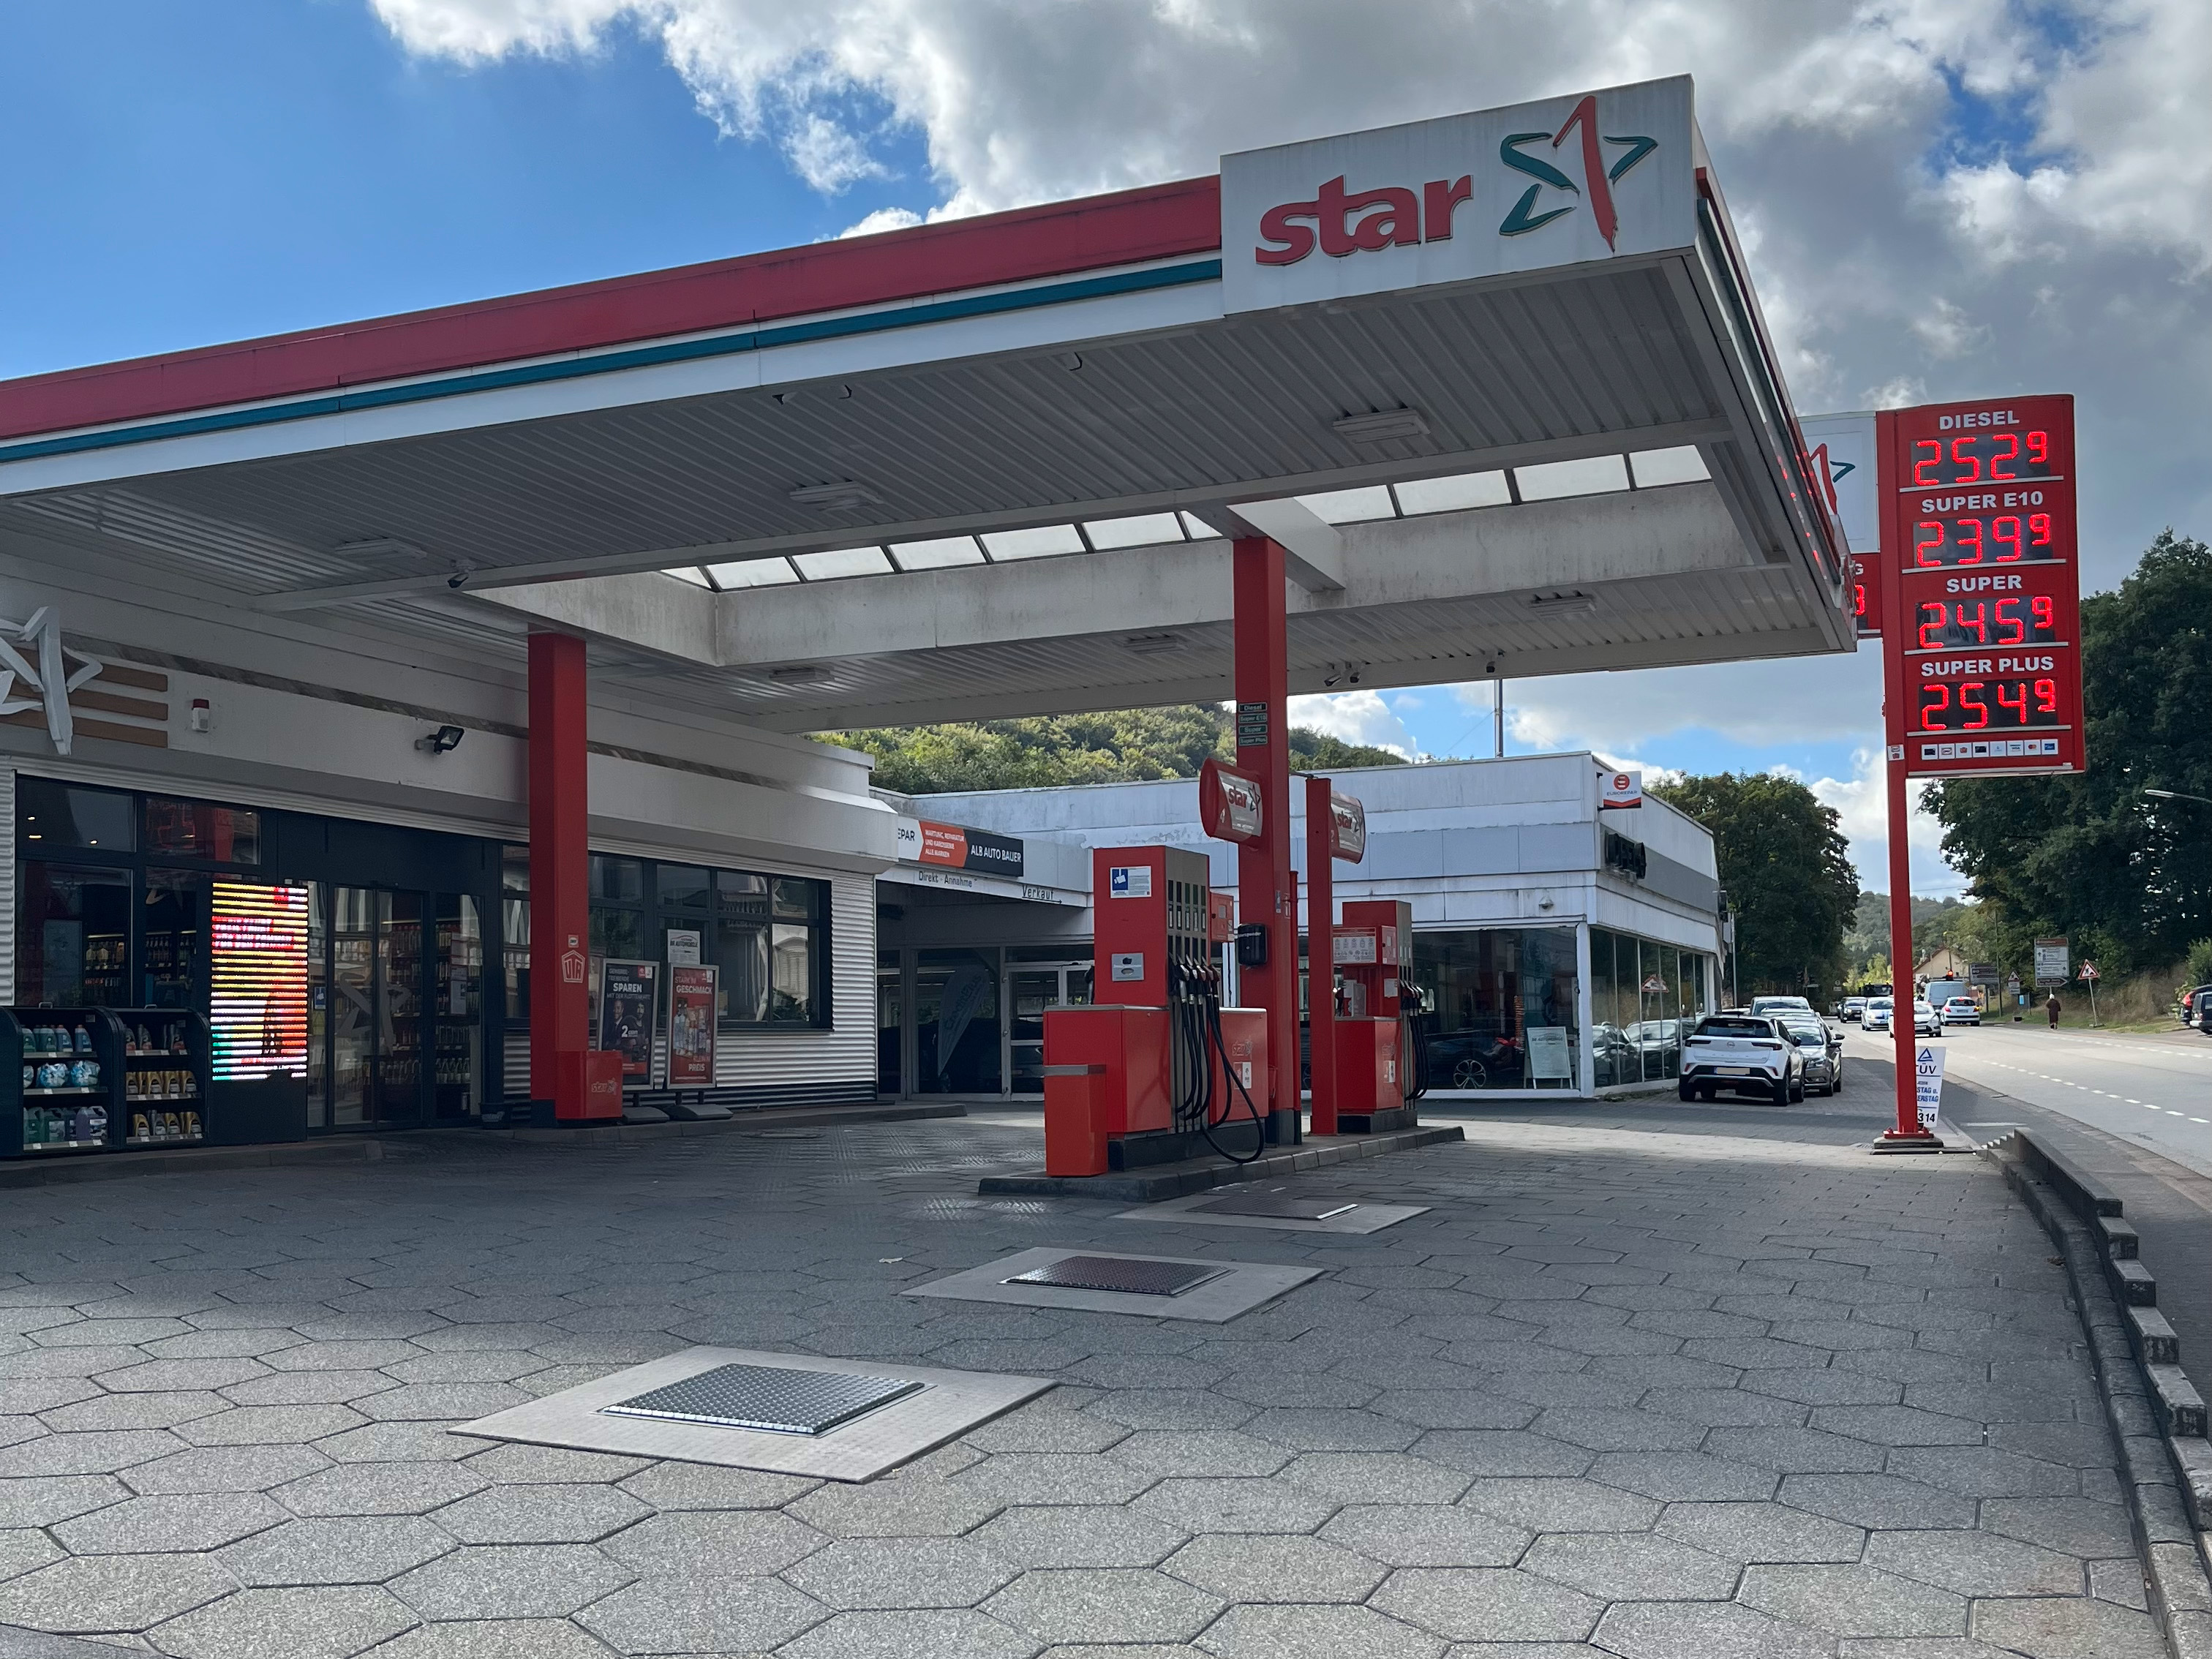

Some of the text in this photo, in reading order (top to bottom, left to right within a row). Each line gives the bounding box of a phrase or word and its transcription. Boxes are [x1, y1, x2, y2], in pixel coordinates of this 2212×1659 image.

[1255, 175, 1473, 266] star
[1940, 411, 2020, 429] DIESEL
[1922, 491, 2042, 513] SUPER E10
[1946, 575, 2022, 592] SUPER
[1922, 657, 2054, 676] SUPER PLUS
[1229, 785, 1246, 808] star
[1337, 810, 1352, 830] star
[971, 845, 1021, 862] ALB AUTO BAUER
[919, 870, 972, 887] Direkt Annahme
[1022, 885, 1053, 900] Verkauf
[613, 983, 642, 993] SPAREN
[676, 985, 712, 994] GESCHMACK
[622, 1026, 628, 1037] 2
